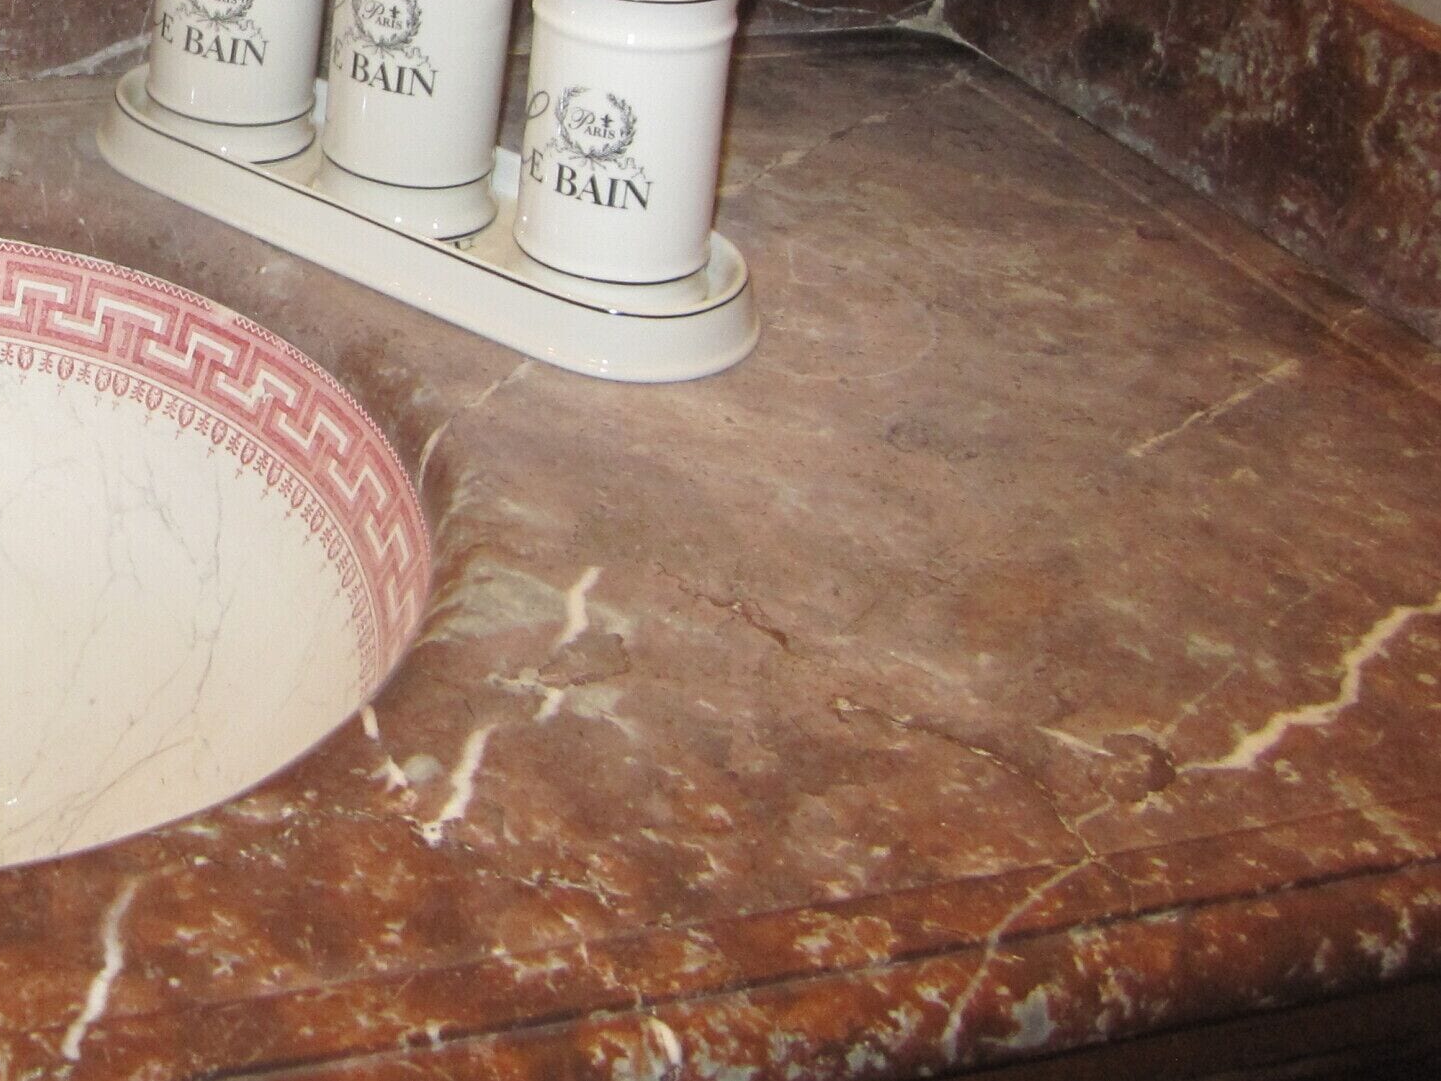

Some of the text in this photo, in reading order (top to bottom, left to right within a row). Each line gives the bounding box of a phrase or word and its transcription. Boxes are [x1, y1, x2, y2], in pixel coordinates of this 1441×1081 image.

[184, 24, 269, 67] BAIN
[351, 50, 439, 97] BAIN
[555, 162, 655, 211] BAIN
